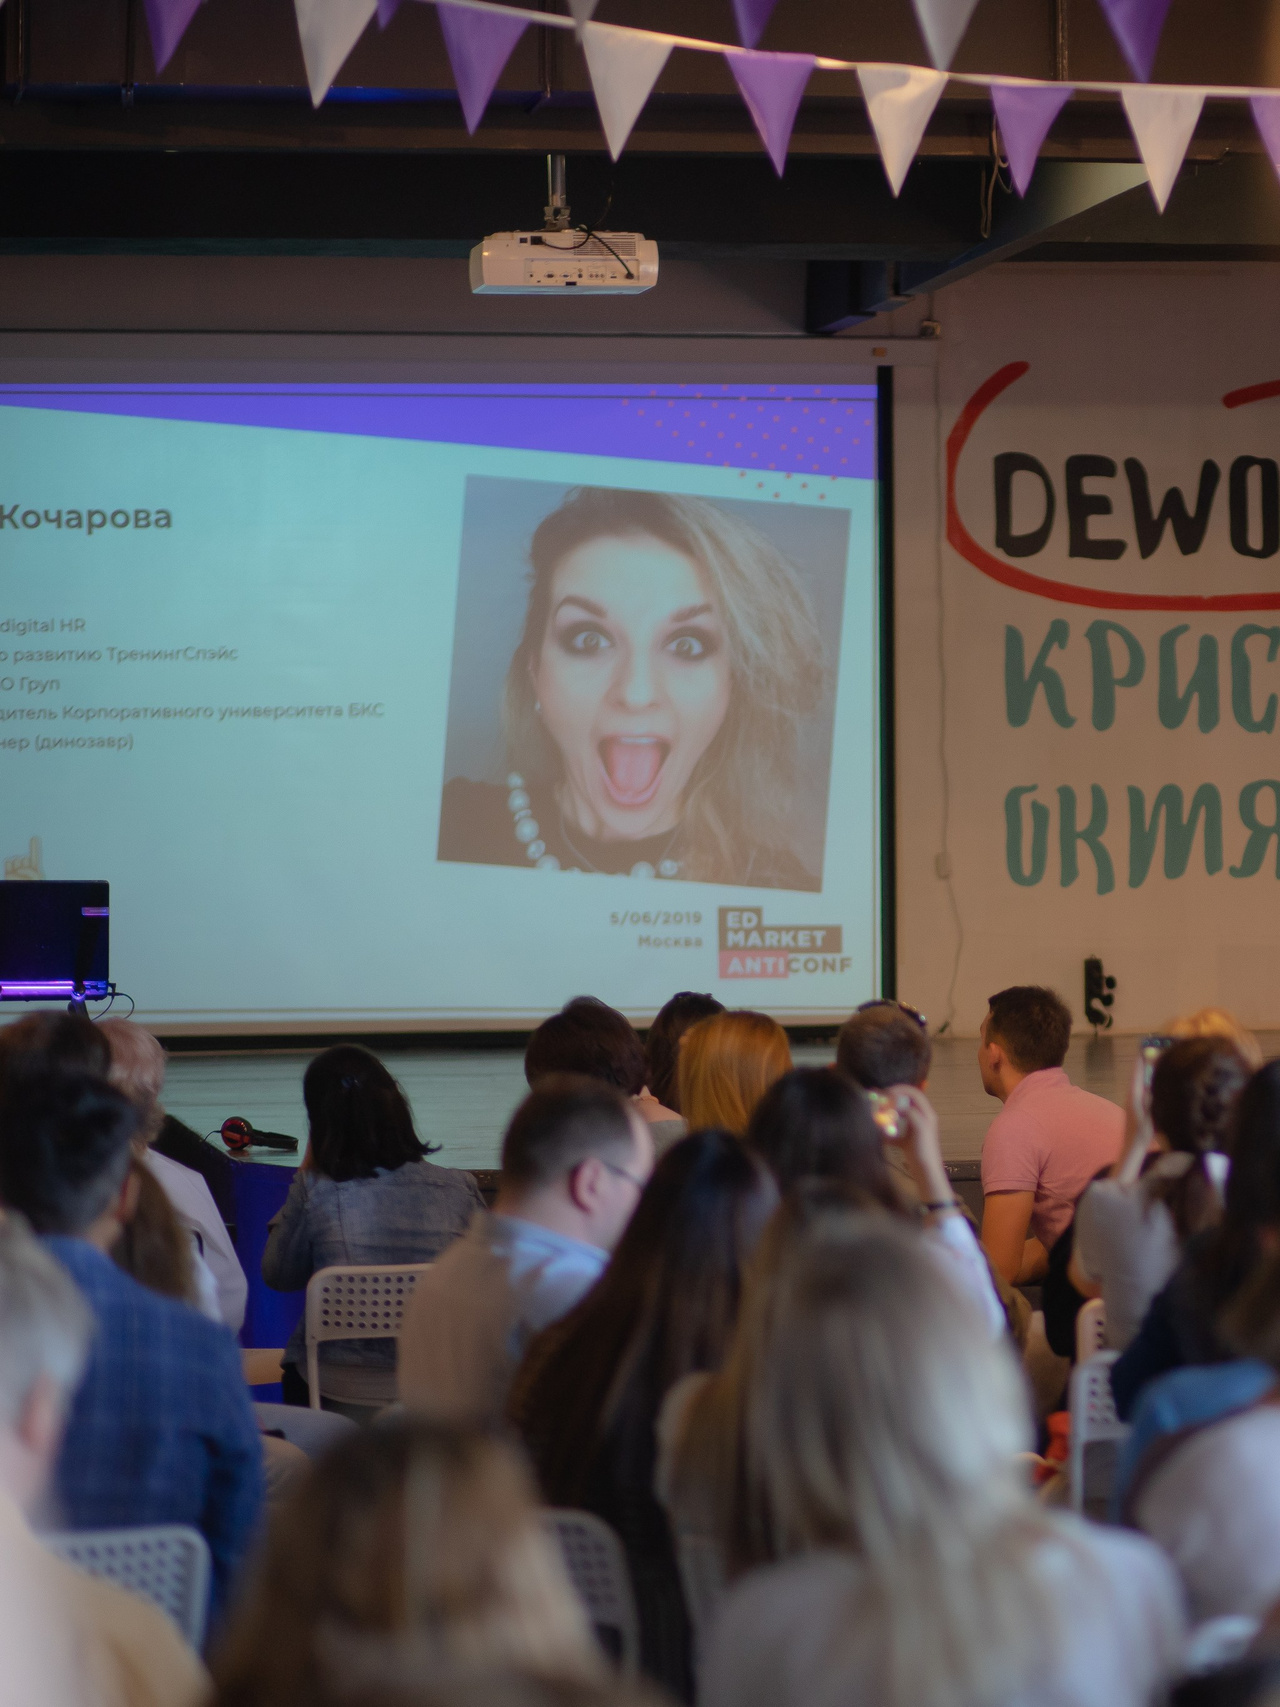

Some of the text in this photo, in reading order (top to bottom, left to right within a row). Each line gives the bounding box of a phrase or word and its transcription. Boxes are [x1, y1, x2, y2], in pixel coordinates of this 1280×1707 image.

[0, 503, 172, 535] Кочарова
[0, 617, 86, 636] digital HR
[13, 650, 102, 665] развитию
[20, 676, 60, 695] Груп
[62, 705, 214, 723] Корпоративного
[218, 704, 344, 722] университета
[348, 702, 385, 718] БКС
[35, 734, 134, 752] (динозавр)
[610, 912, 702, 925] 5/06/2019
[727, 912, 757, 927] ED
[638, 935, 702, 948] Москва
[727, 931, 826, 947] MARKET
[727, 957, 852, 974] ANTICONF
